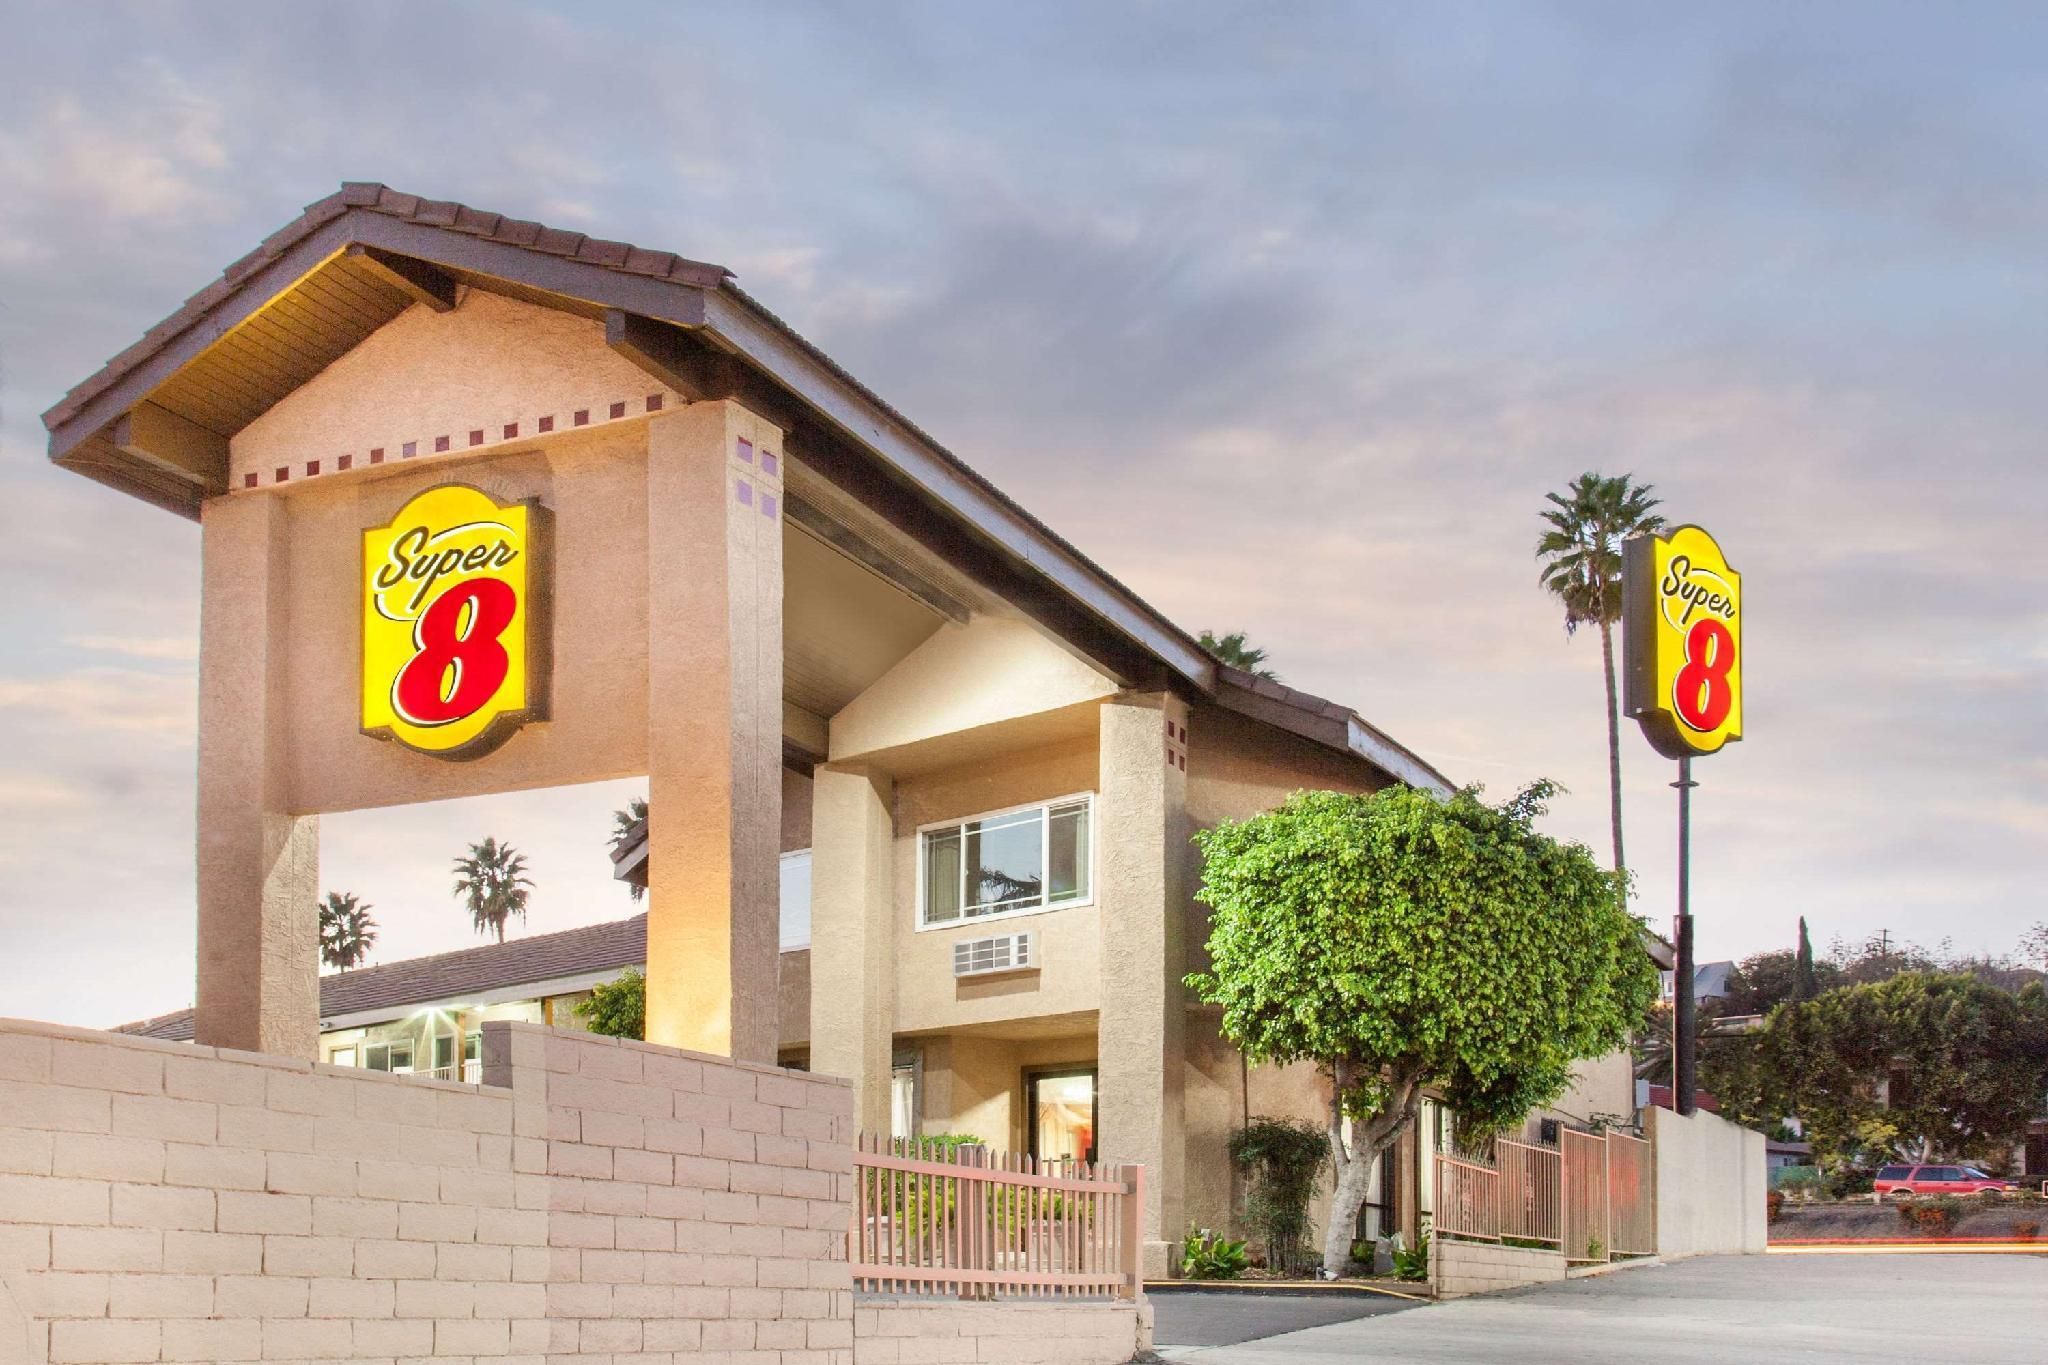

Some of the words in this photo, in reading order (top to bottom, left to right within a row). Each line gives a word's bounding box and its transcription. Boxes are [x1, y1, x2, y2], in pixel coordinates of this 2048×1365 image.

[374, 526, 519, 612] Super
[1662, 555, 1735, 625] Super
[390, 577, 517, 728] 8
[1673, 618, 1735, 732] 8
